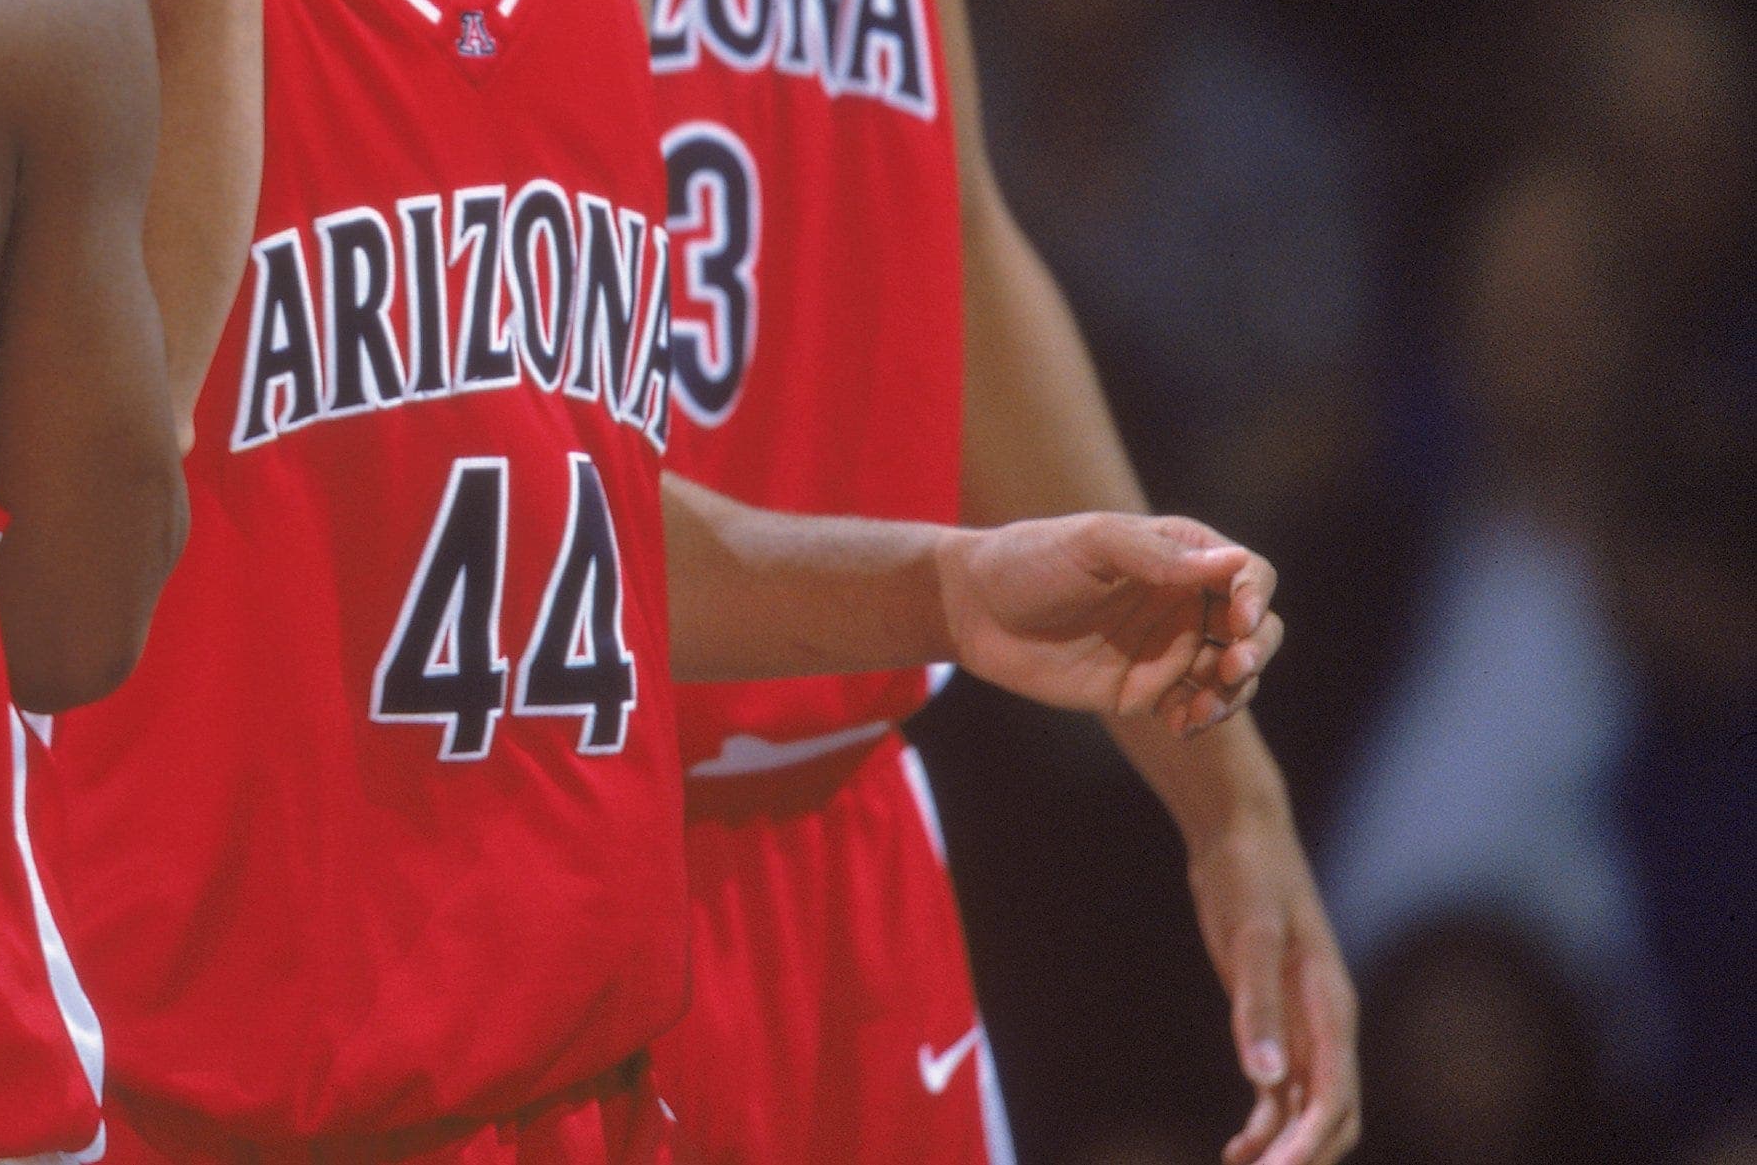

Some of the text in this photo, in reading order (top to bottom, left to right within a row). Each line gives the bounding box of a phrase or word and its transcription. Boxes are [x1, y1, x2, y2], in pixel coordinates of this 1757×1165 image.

[457, 10, 496, 57] A
[229, 177, 671, 454] ARIZONA
[660, 120, 763, 429] 3
[370, 452, 636, 762] 44
